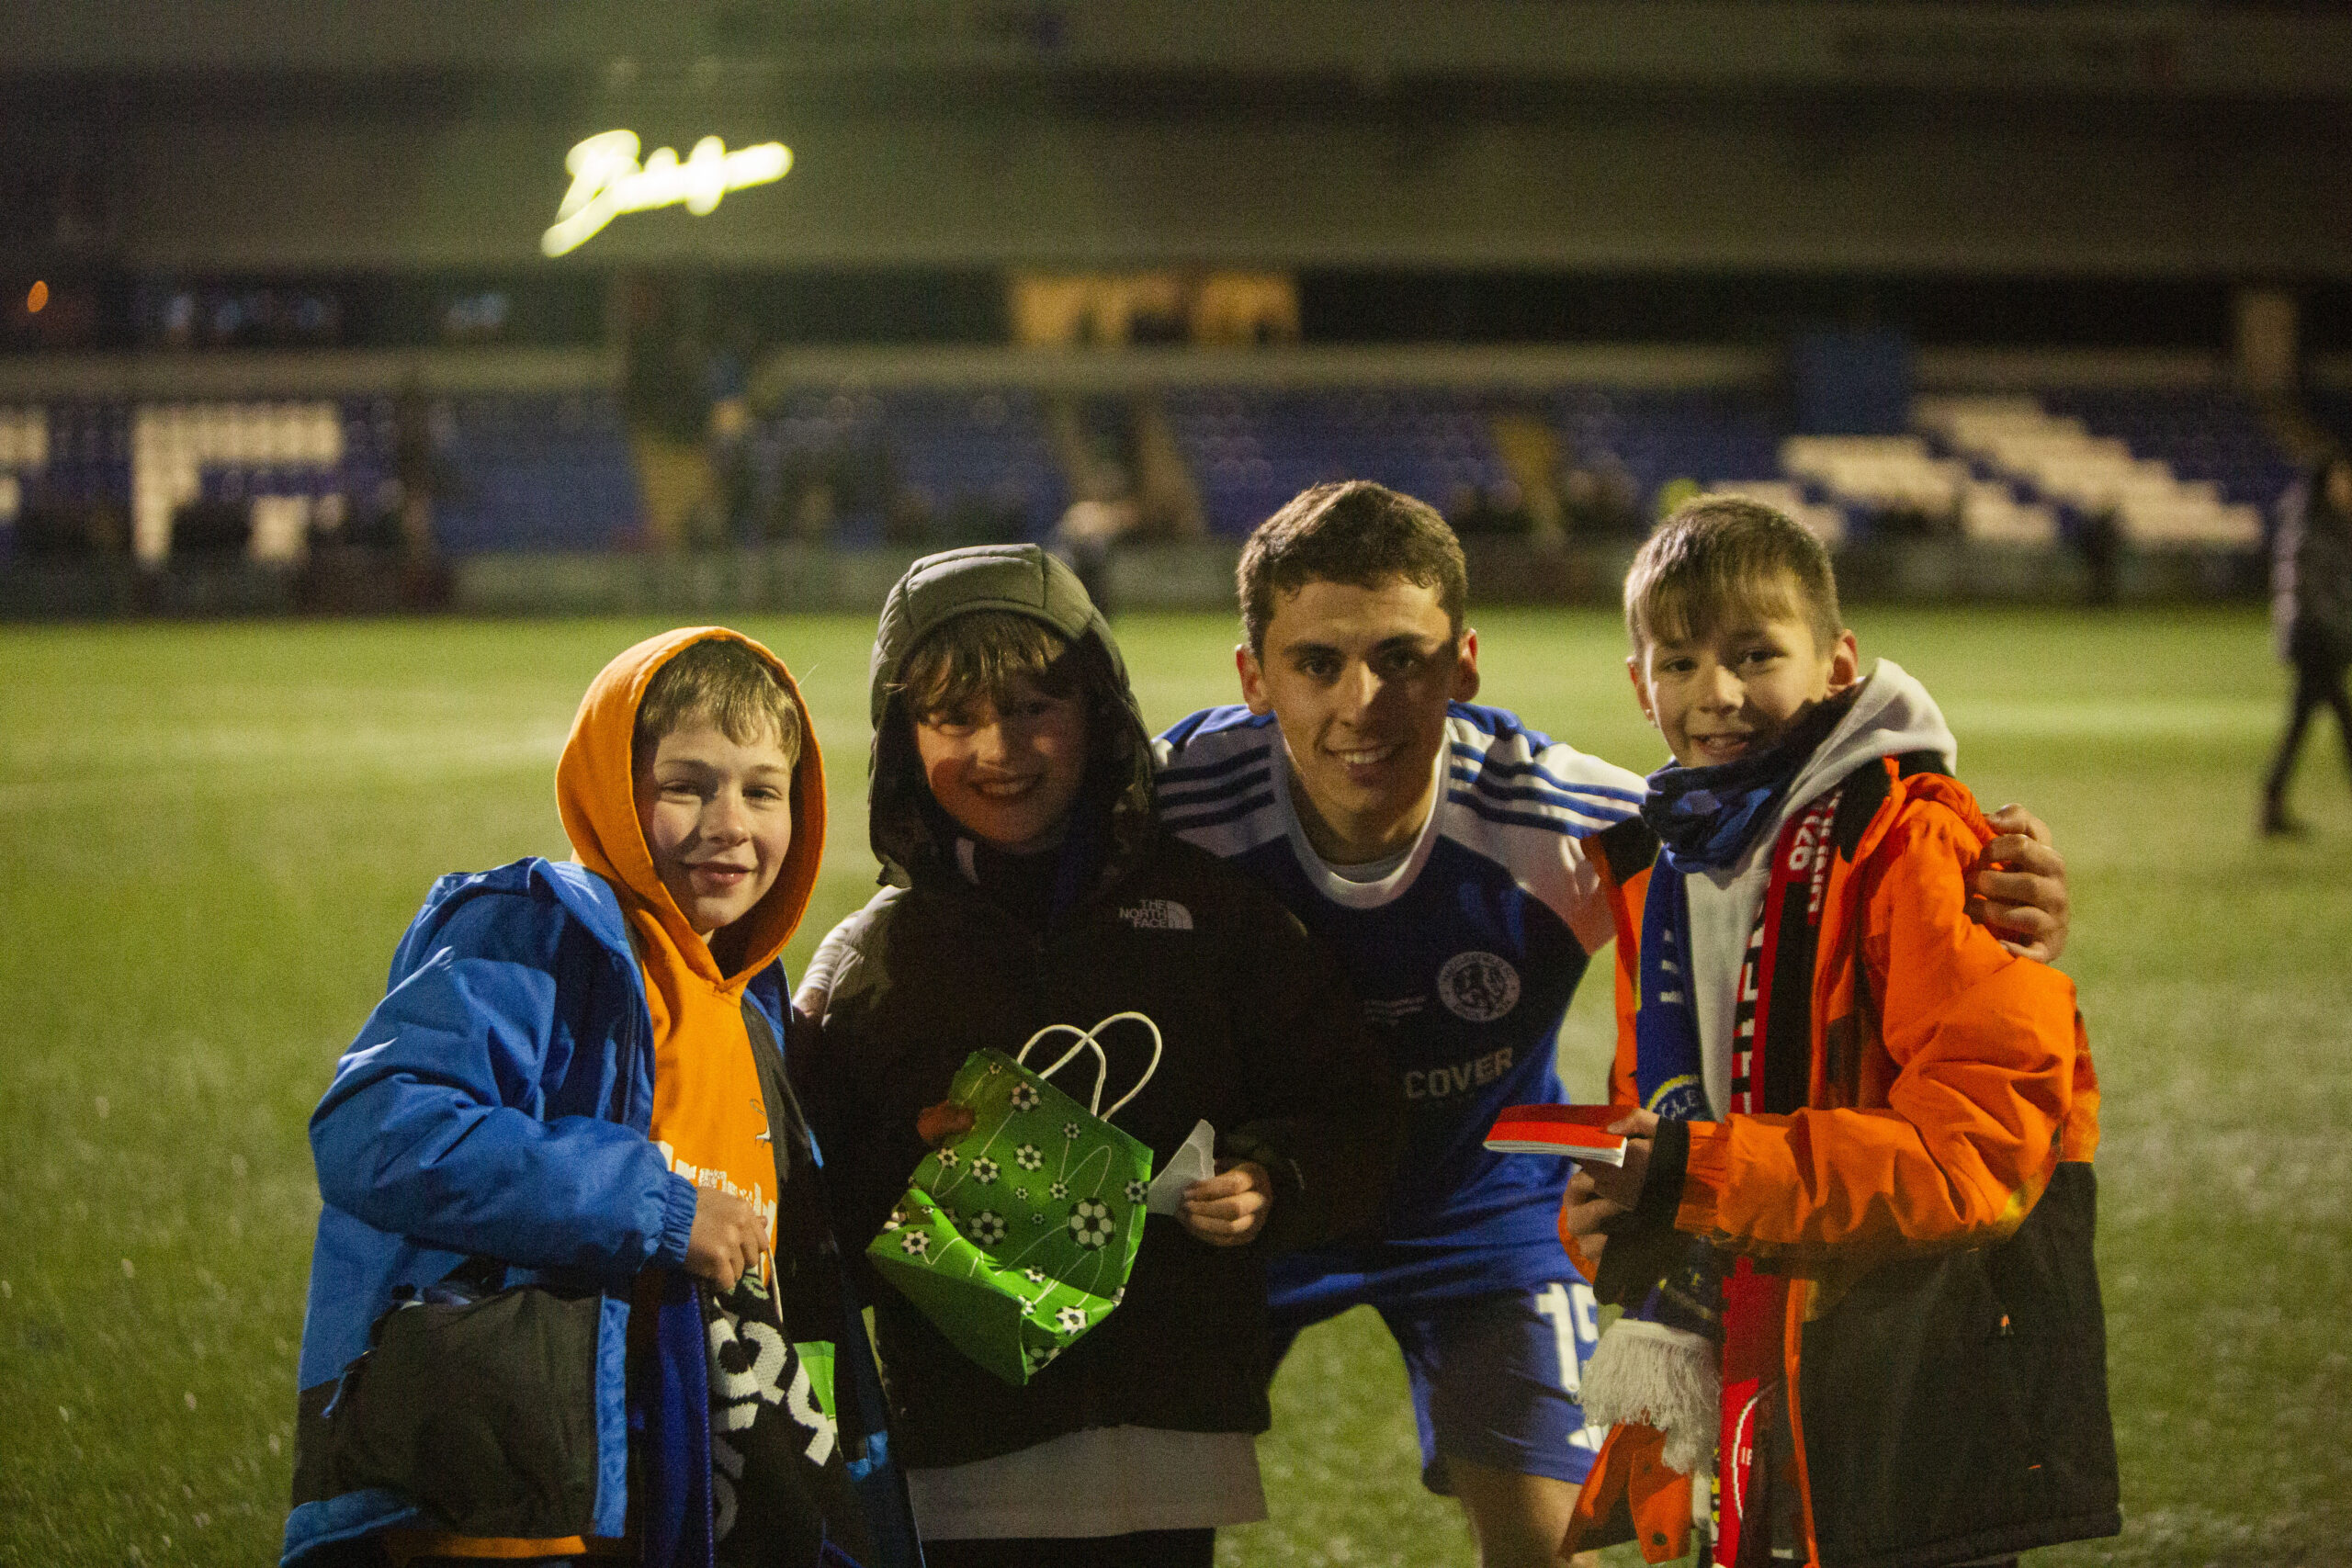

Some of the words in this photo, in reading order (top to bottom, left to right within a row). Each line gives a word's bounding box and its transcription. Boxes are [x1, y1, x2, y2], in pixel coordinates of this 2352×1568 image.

[1140, 899, 1167, 908] THE
[1120, 908, 1167, 919] NORTH
[1134, 919, 1167, 929] FACE
[1405, 1046, 1514, 1100] COVER
